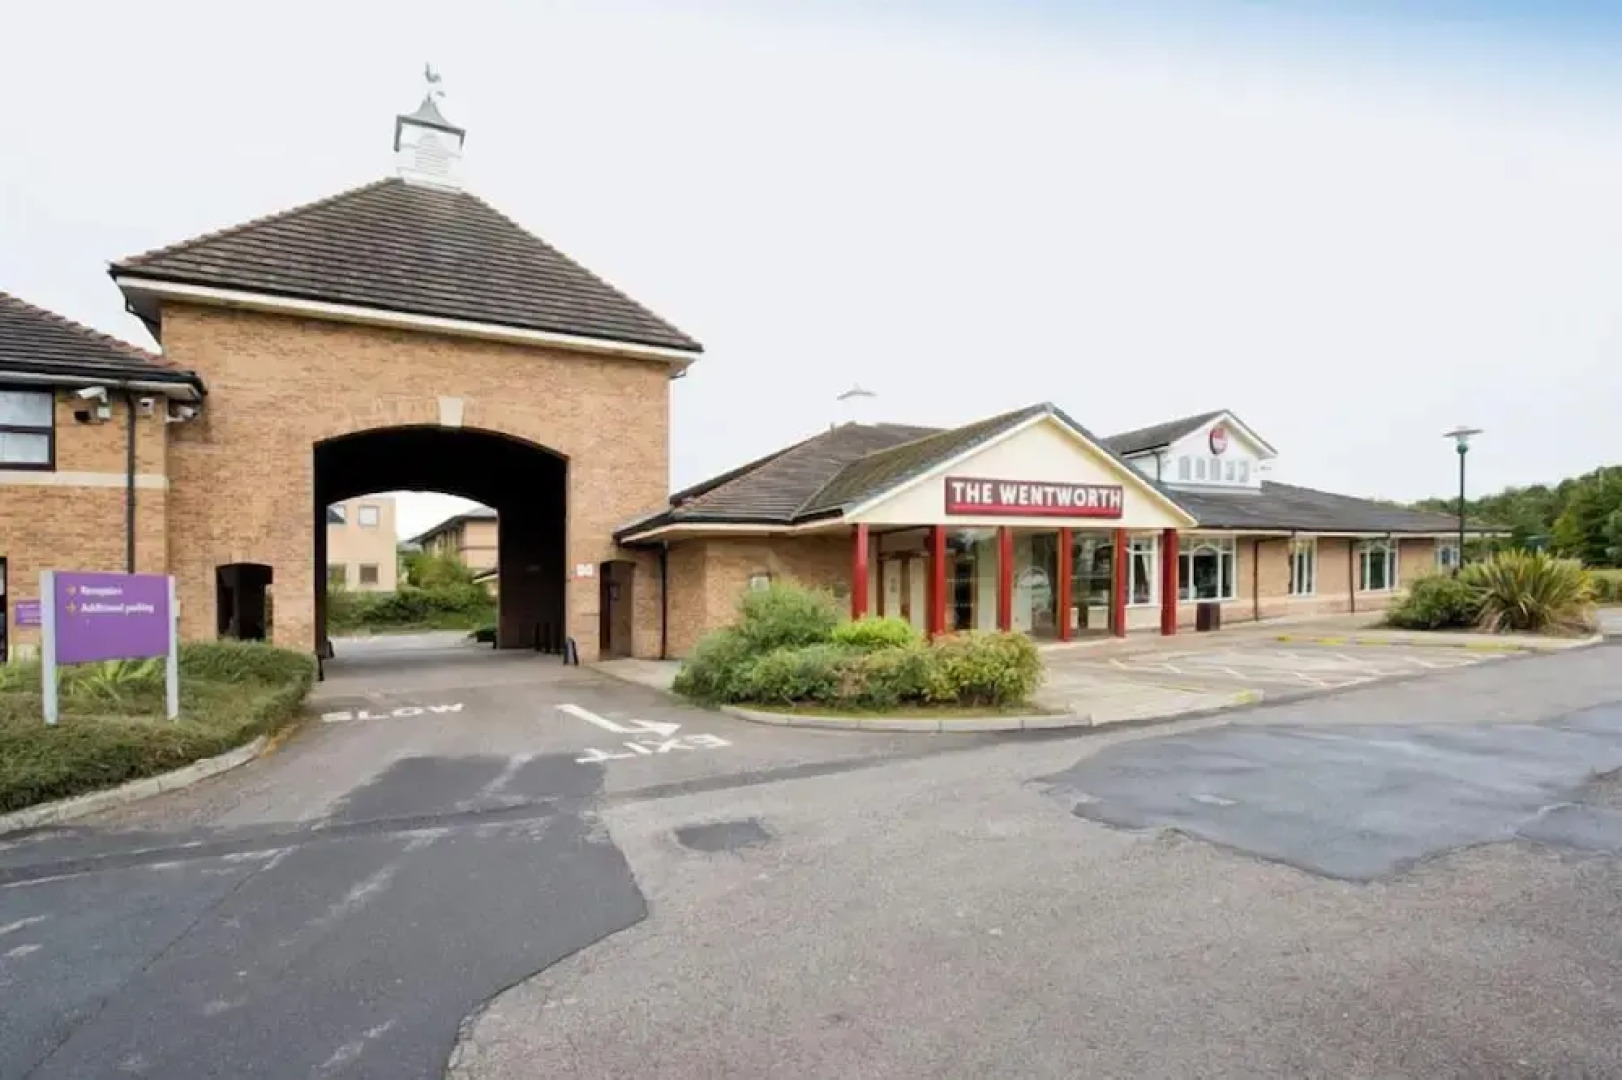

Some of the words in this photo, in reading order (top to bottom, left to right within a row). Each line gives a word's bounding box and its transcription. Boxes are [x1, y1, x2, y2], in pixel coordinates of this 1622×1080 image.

[951, 482, 994, 505] THE
[999, 484, 1122, 511] WENTWORTH
[80, 602, 124, 614] Additional
[125, 603, 155, 616] parking
[321, 703, 465, 723] SLOW
[574, 733, 734, 764] EXIT
